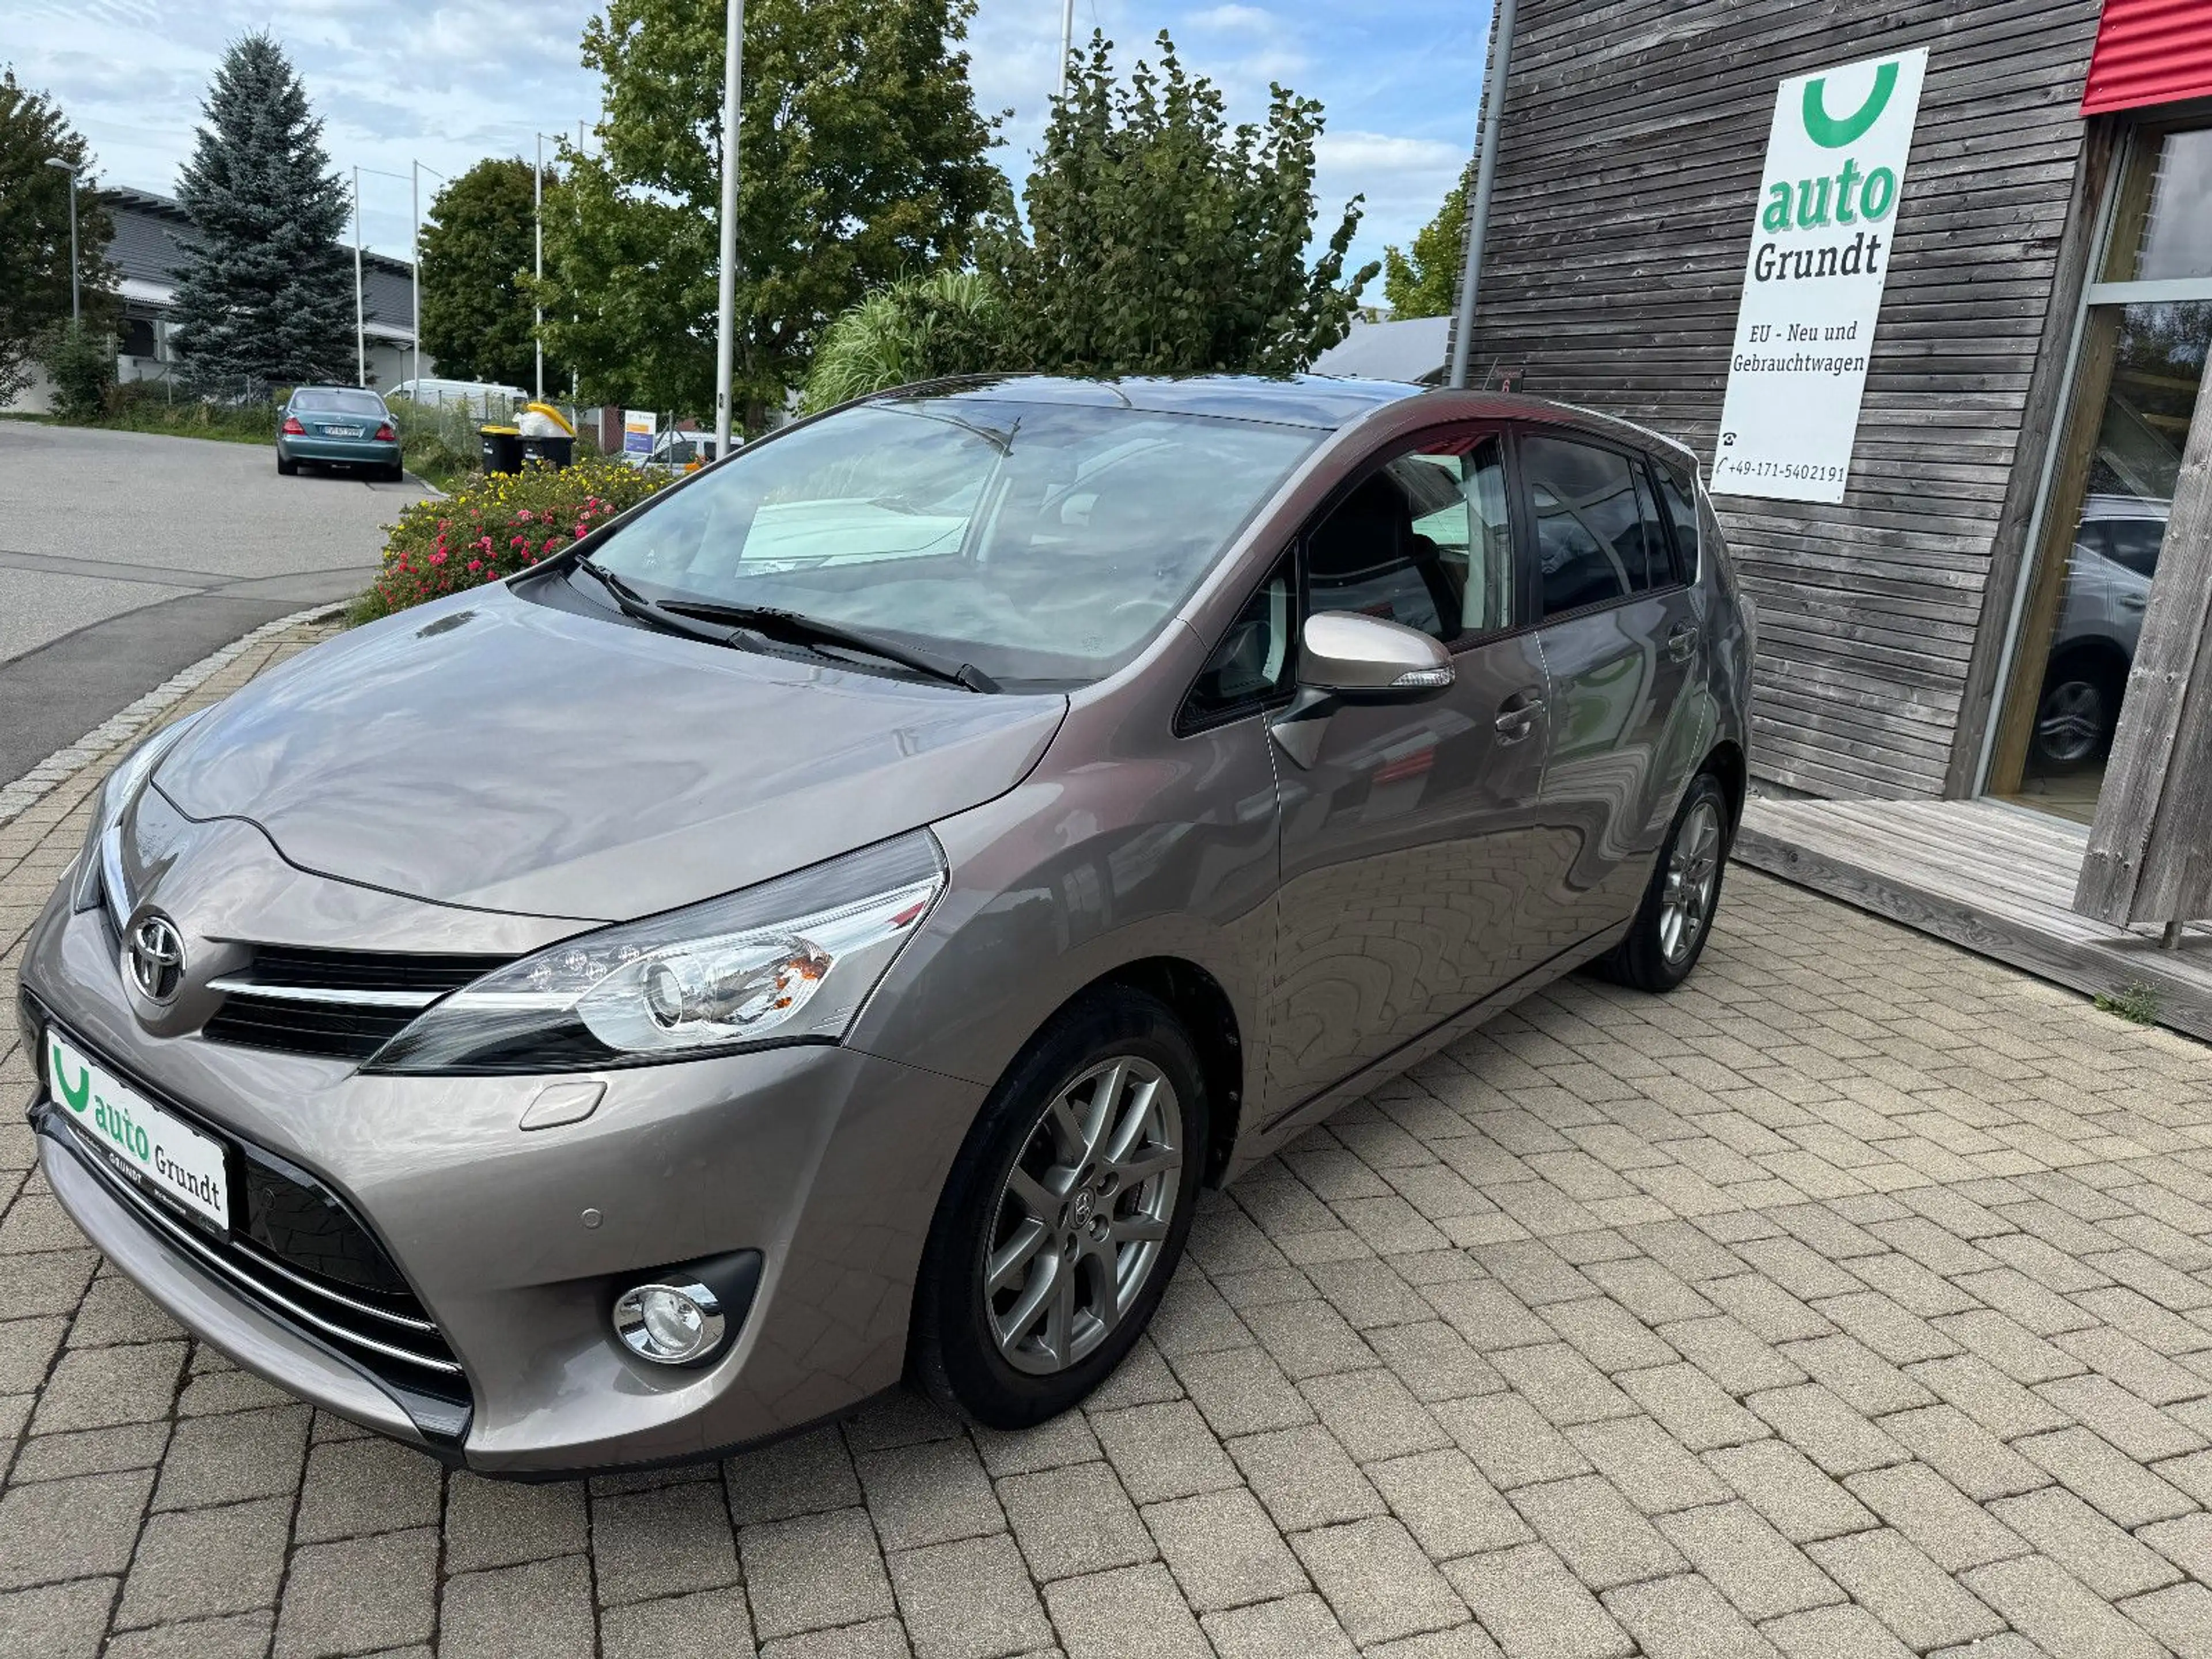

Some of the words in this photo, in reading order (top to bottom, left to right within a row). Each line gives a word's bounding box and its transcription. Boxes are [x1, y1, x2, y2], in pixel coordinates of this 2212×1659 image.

[1762, 157, 1897, 234] auto
[1755, 232, 1881, 282] Grundt
[1749, 324, 1771, 342] EU
[1786, 323, 1818, 341] Neu
[1824, 320, 1858, 340] und
[1733, 353, 1865, 376] Gebrauchtwagen
[1729, 460, 1844, 482] +49-171-5402191
[94, 1094, 150, 1163] auto
[154, 1144, 221, 1212] Grundt
